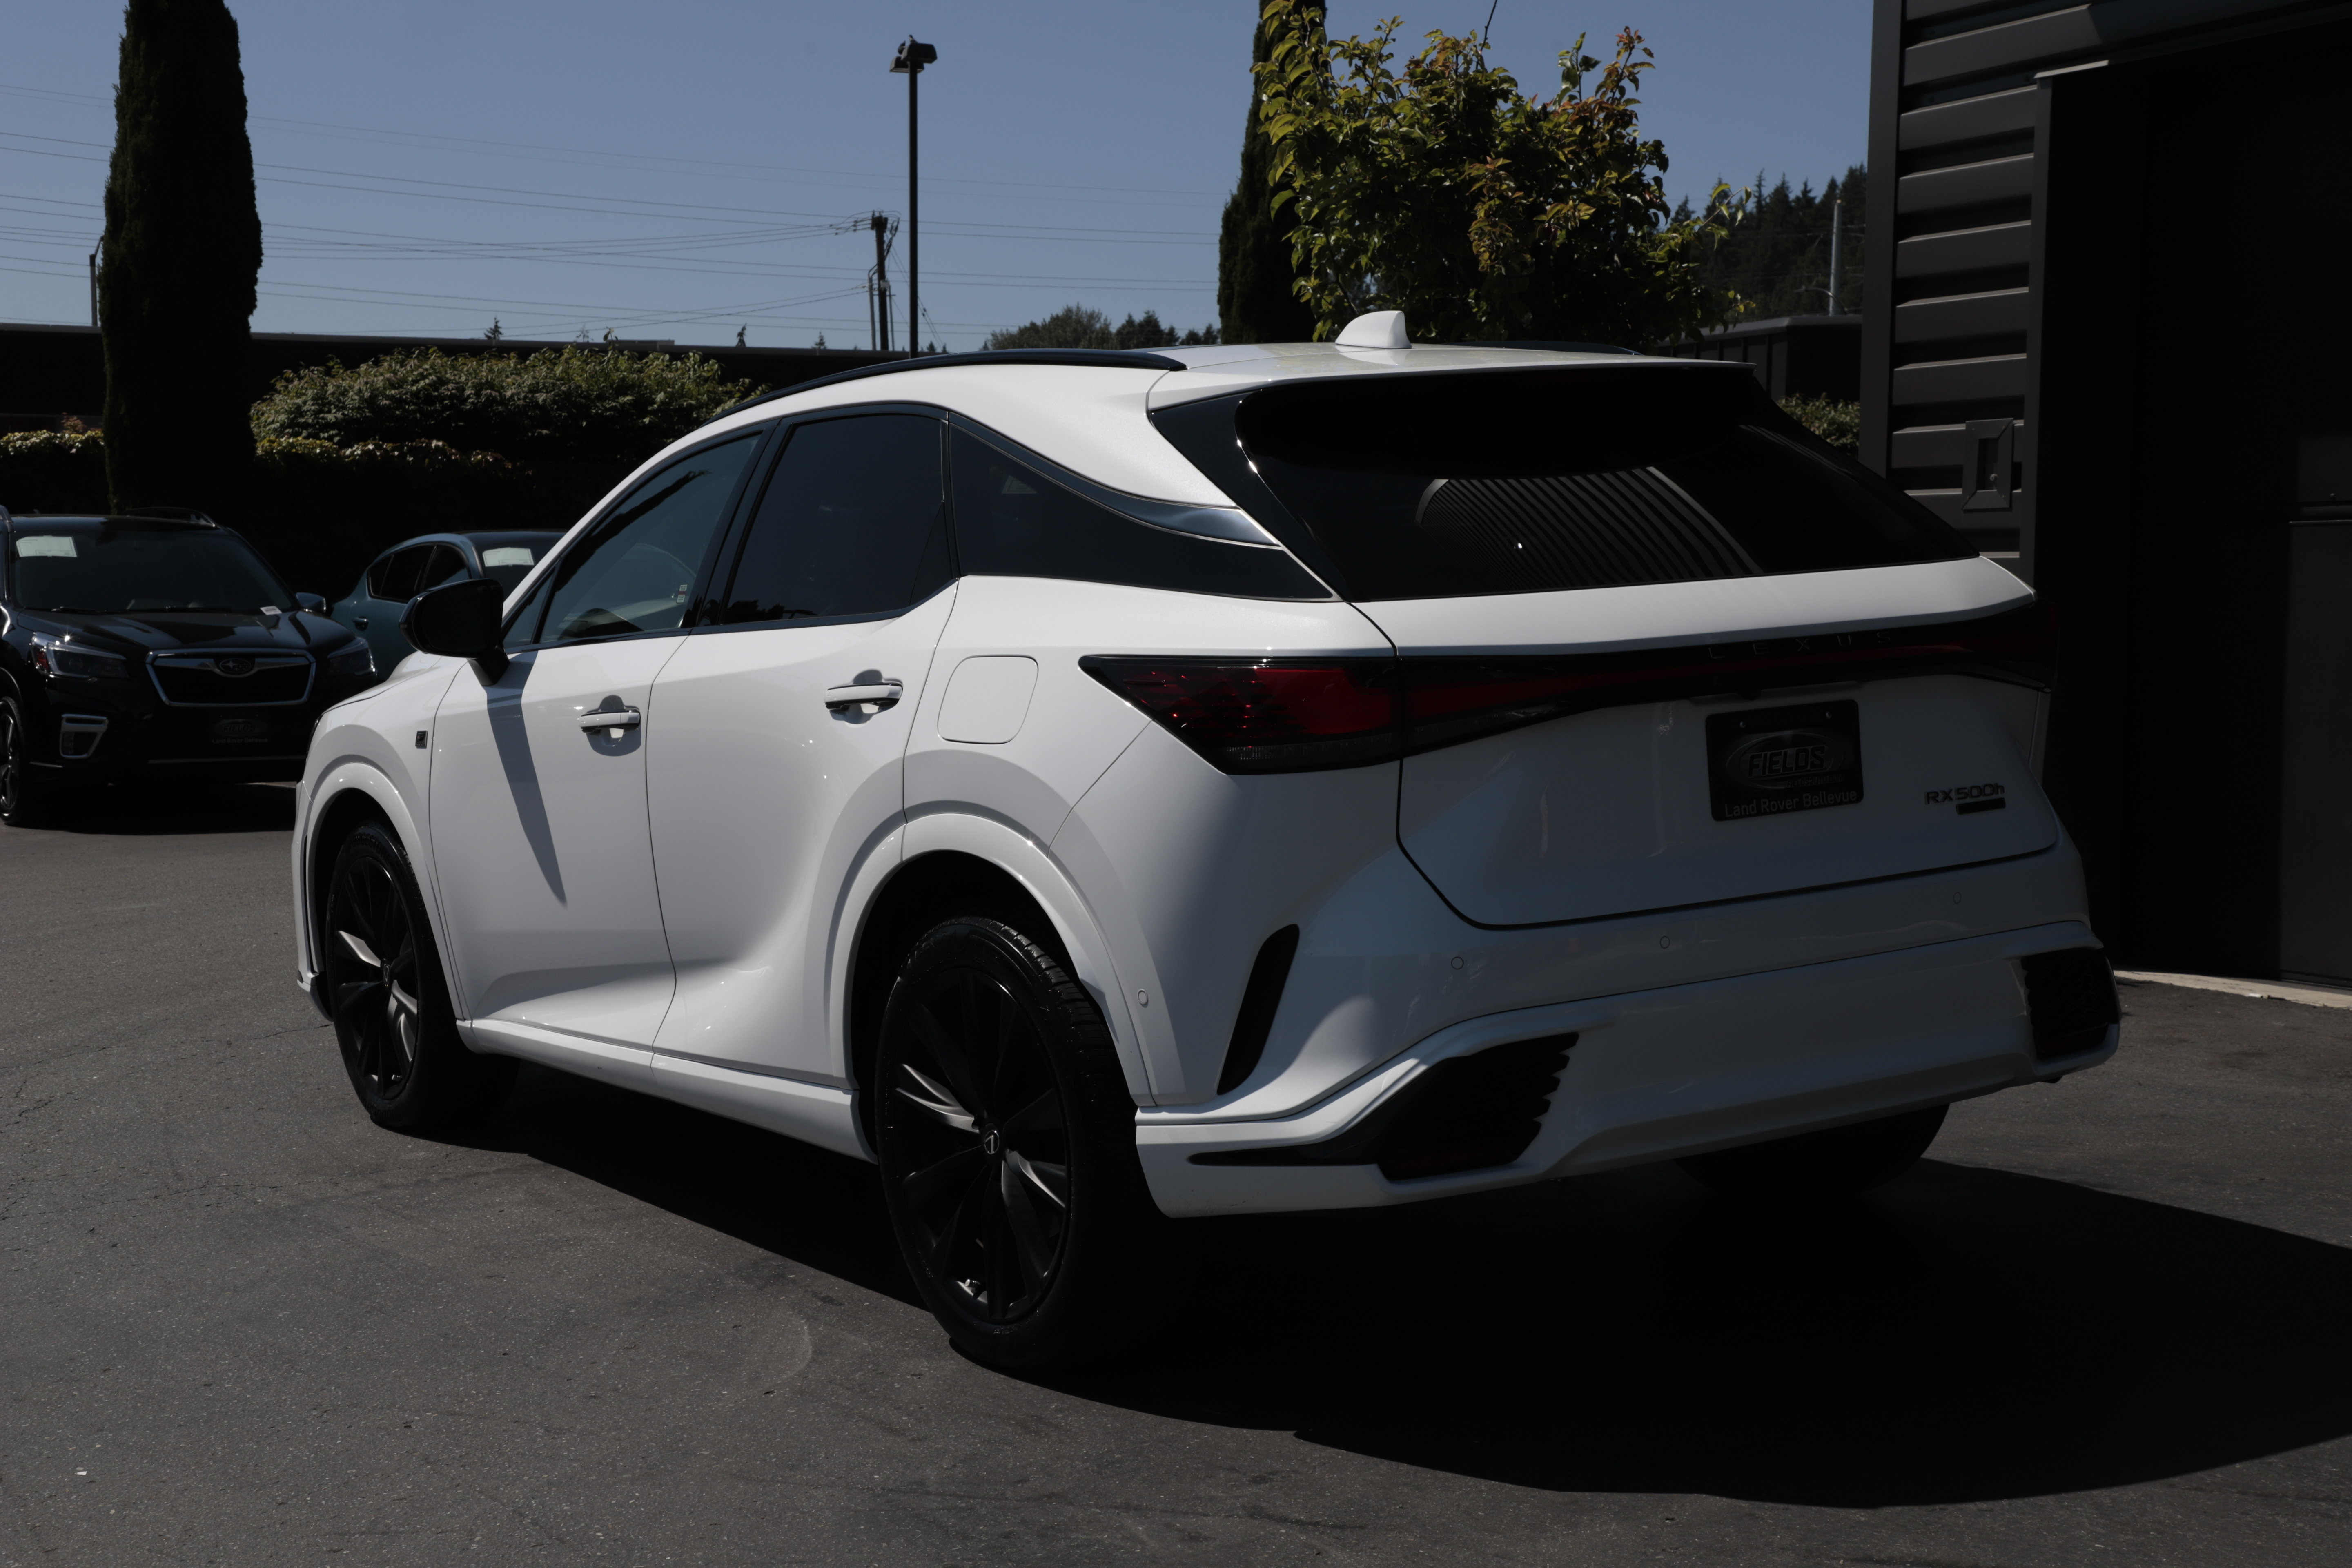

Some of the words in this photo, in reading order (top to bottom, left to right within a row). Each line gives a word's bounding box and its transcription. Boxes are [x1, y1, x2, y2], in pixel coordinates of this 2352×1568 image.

[1708, 631, 1891, 659] LEXUS
[1748, 745, 1825, 777] FIELDS
[1724, 799, 1757, 817] Land
[1760, 797, 1800, 813] Rover
[1802, 790, 1857, 808] Bellevue
